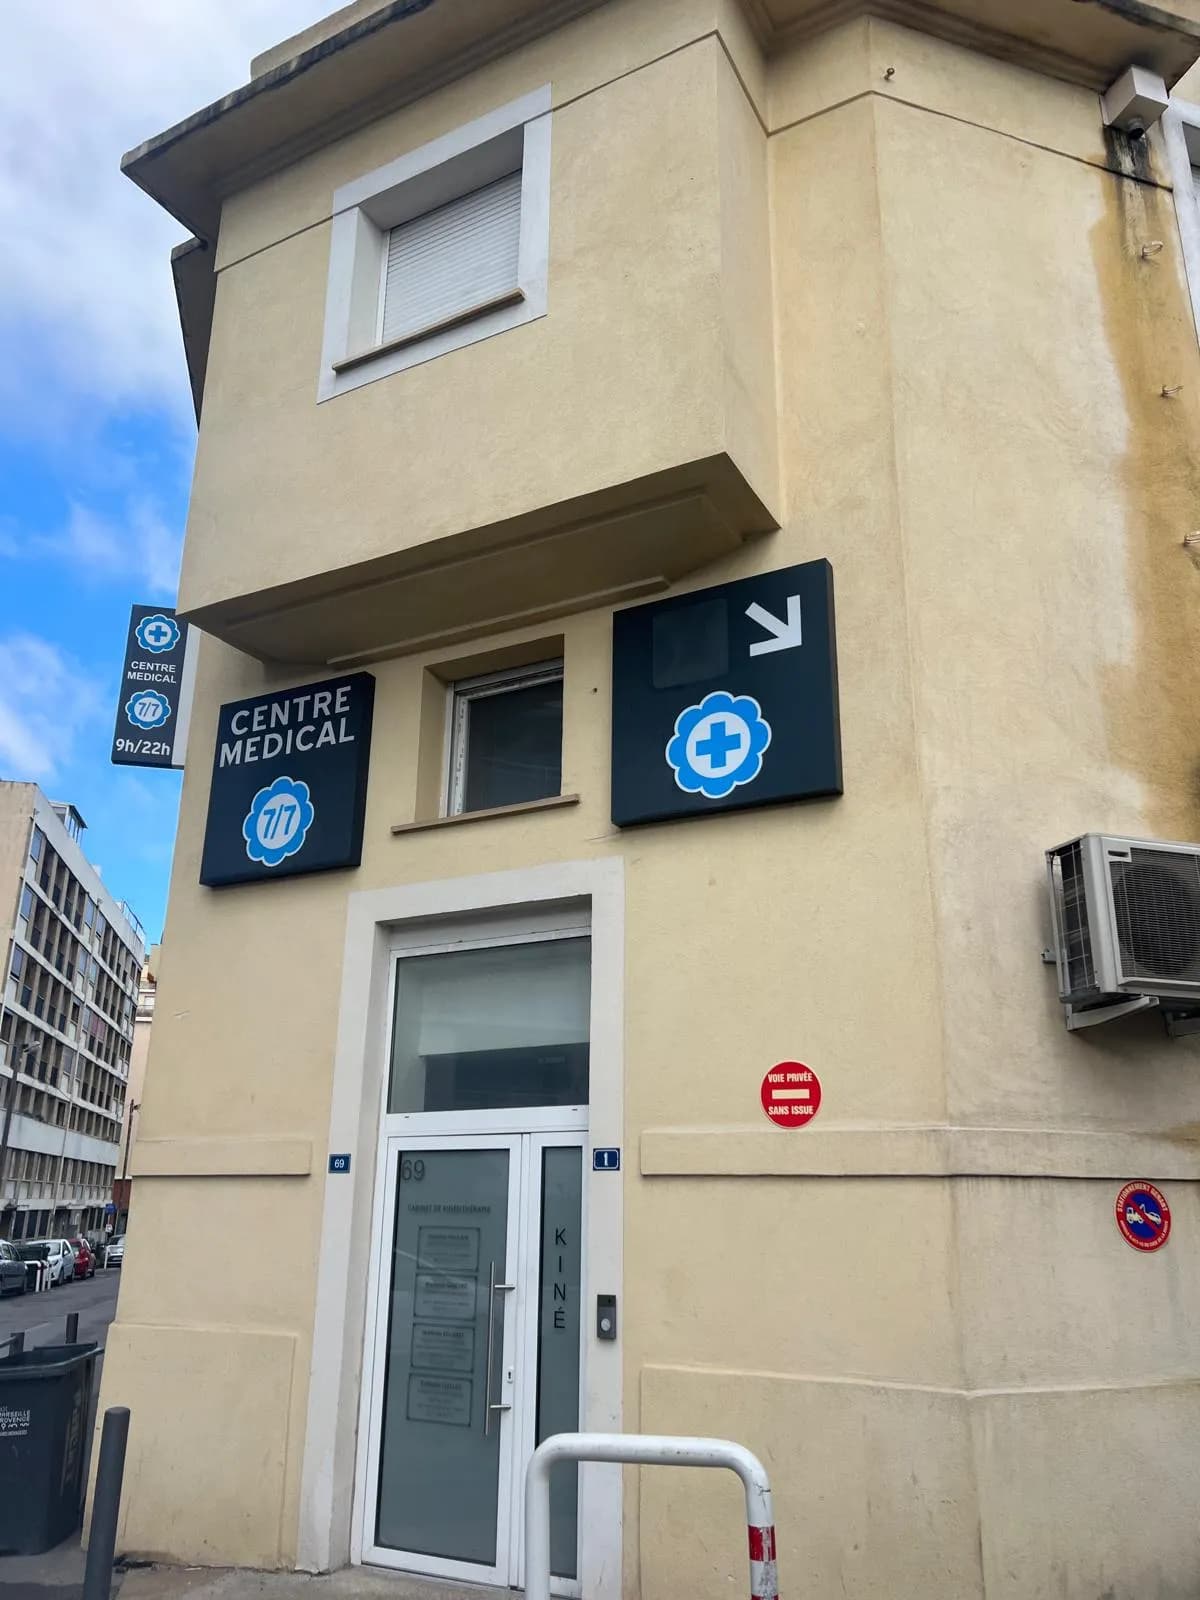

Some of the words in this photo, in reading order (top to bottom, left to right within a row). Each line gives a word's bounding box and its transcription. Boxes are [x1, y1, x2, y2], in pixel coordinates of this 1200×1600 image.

[131, 661, 176, 673] CENTRE
[127, 671, 177, 684] MEDICAL
[138, 702, 160, 717] 7/7
[230, 685, 352, 736] CENTRE
[115, 738, 171, 756] 9h/22h
[219, 717, 355, 768] MEDICAL
[263, 804, 297, 840] 7/7
[768, 1073, 785, 1083] VOIE
[786, 1071, 813, 1083] PRIVÉE
[768, 1105, 790, 1115] SANS
[791, 1105, 814, 1115] ISSUE
[334, 1158, 345, 1169] 69
[603, 1151, 609, 1167] 1
[402, 1159, 426, 1182] 69
